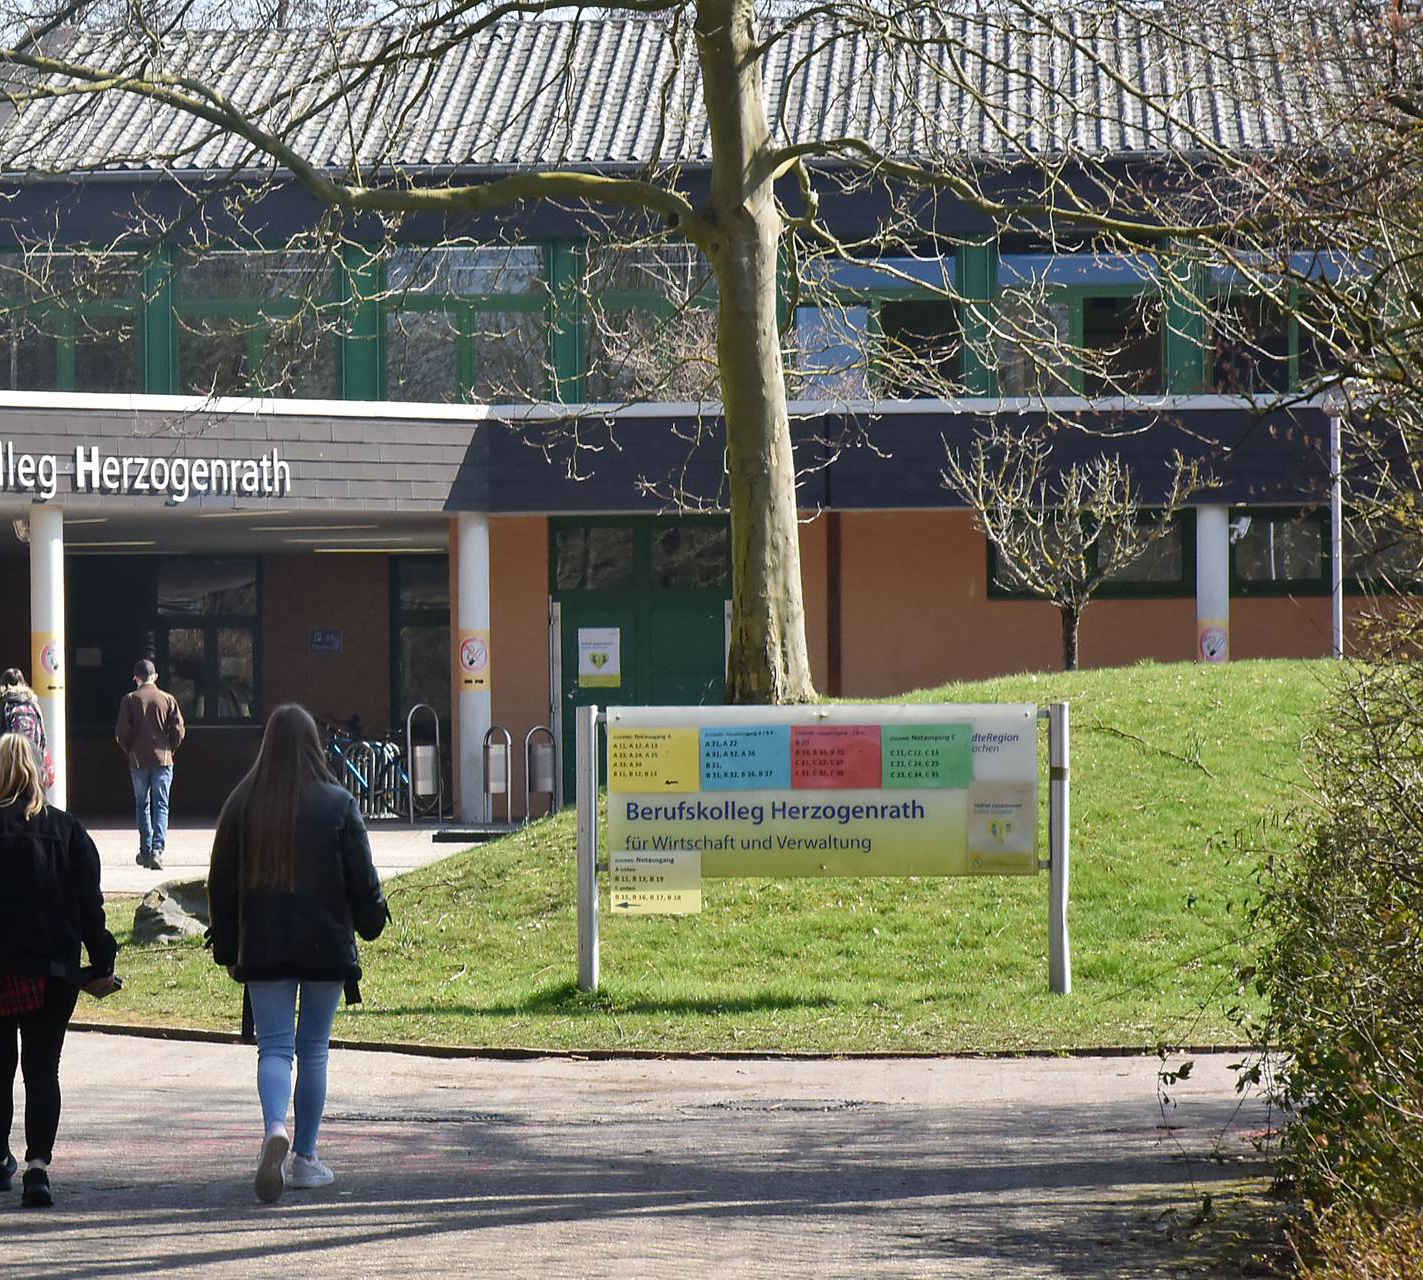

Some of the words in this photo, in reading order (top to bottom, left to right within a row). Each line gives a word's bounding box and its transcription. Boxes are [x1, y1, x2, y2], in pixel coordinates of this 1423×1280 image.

[75, 446, 291, 502] Herzogenrath
[626, 801, 764, 825] Berufskolleg
[771, 800, 925, 824] Herzogenrath
[626, 835, 648, 850] für
[651, 835, 735, 851] Wirtschaft
[741, 835, 772, 850] und
[777, 835, 871, 853] Verwaltung
